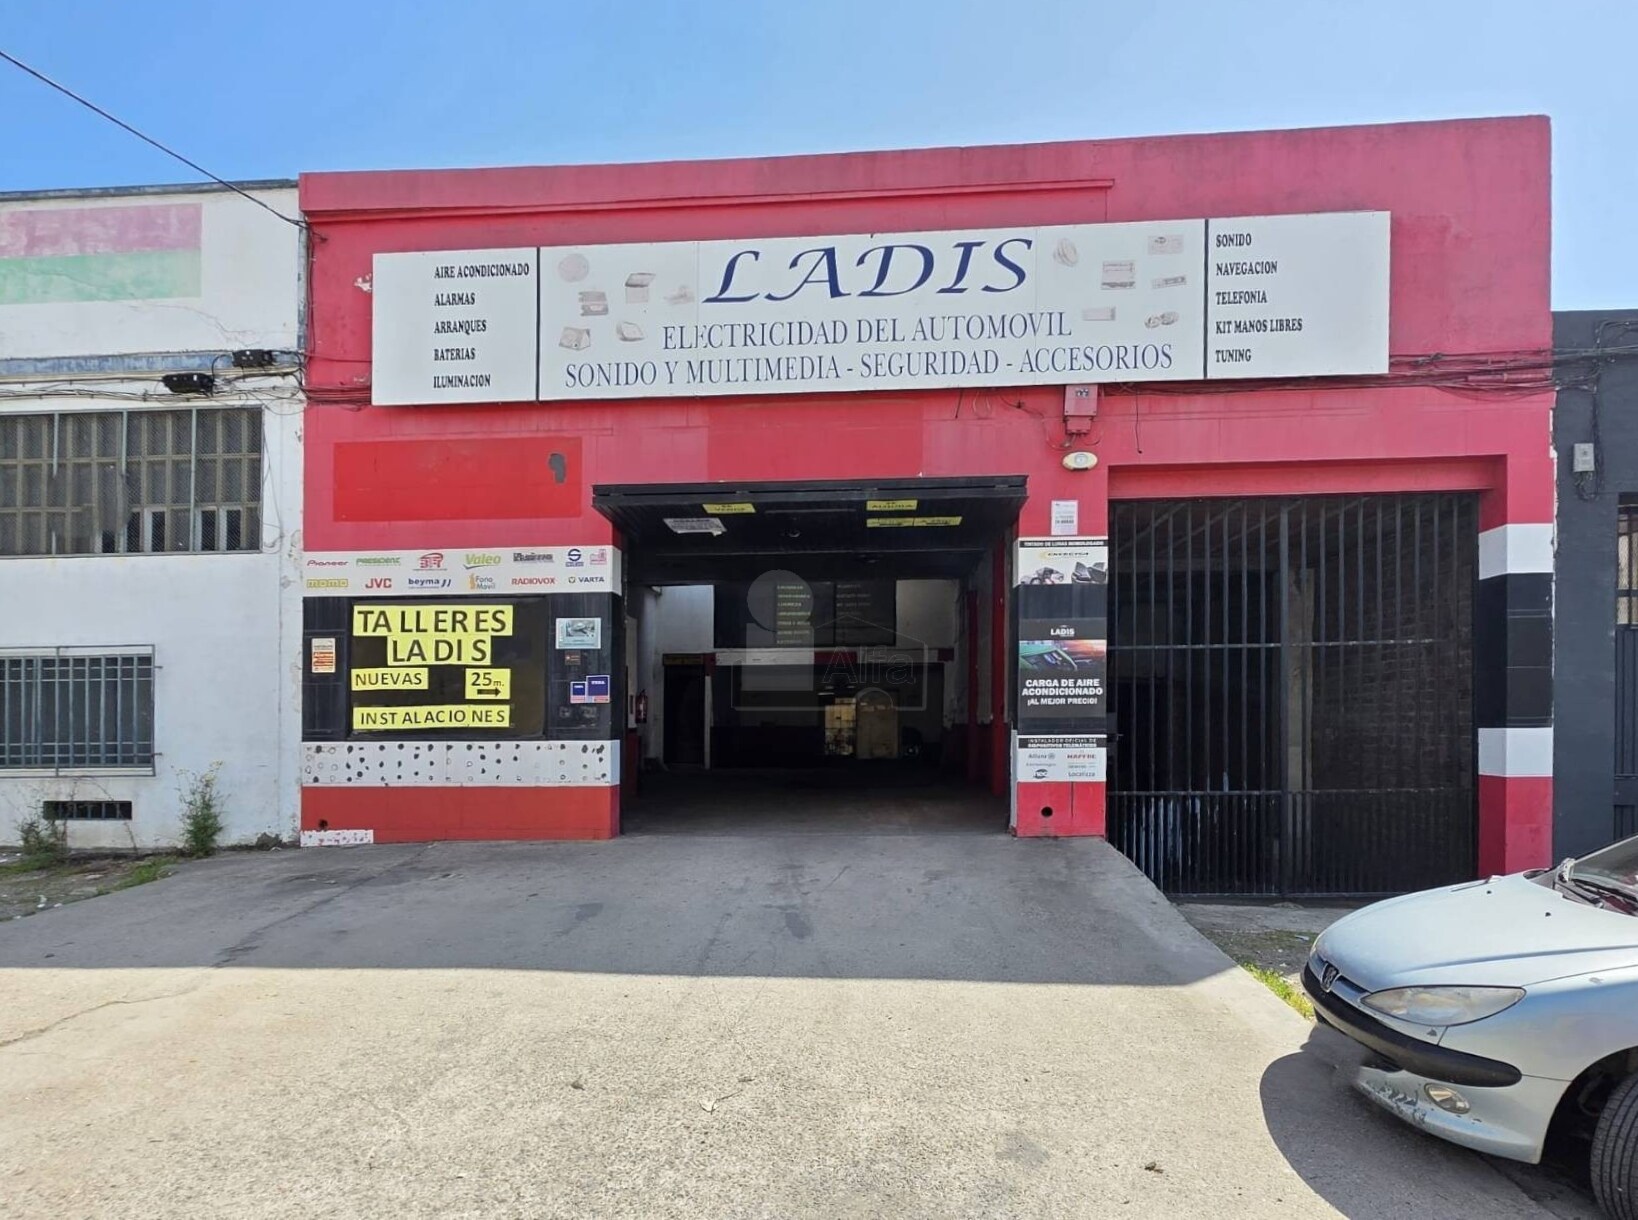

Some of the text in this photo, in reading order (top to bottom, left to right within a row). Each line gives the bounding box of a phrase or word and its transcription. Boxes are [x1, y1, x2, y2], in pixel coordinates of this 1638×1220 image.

[1216, 232, 1252, 248] SONIDO
[433, 262, 530, 280] AIRE ACONDICIONADO
[703, 239, 1032, 303] LADIS
[1215, 260, 1278, 276] NAVEGACION
[434, 292, 476, 307] ALARMAS
[1215, 290, 1268, 306] TELEFONIA
[433, 319, 487, 336] ARRANQUES
[662, 311, 1072, 350] ELECTRICIDAD DEL AUTOMOVIL
[1215, 317, 1303, 335] KIT MANOS LIBRES
[433, 347, 476, 362] BATERIAS
[1215, 348, 1252, 363] TUNING
[565, 361, 657, 388] SONIDO
[664, 360, 679, 385] Y
[686, 355, 841, 385] MULTIMEDIA
[860, 349, 999, 378] SEGURIDAD
[1018, 343, 1173, 373] ACCESORIOS
[433, 373, 491, 389] ILUMINACION
[307, 559, 348, 567] Pioneer
[465, 553, 502, 565] Valeo
[365, 577, 392, 589] JVC
[408, 578, 440, 588] beyma
[511, 577, 556, 586] RADIOVOX
[357, 609, 507, 633] TALLERES
[1050, 628, 1075, 636] LADIS
[391, 638, 488, 663] LADIS
[355, 672, 423, 687] NUEVAS
[1025, 678, 1100, 688] CARGA DE AIRE
[1021, 687, 1104, 696] ACONDICIONADO
[1040, 697, 1066, 705] MEJOR
[360, 708, 505, 725] INSTALACIONES
